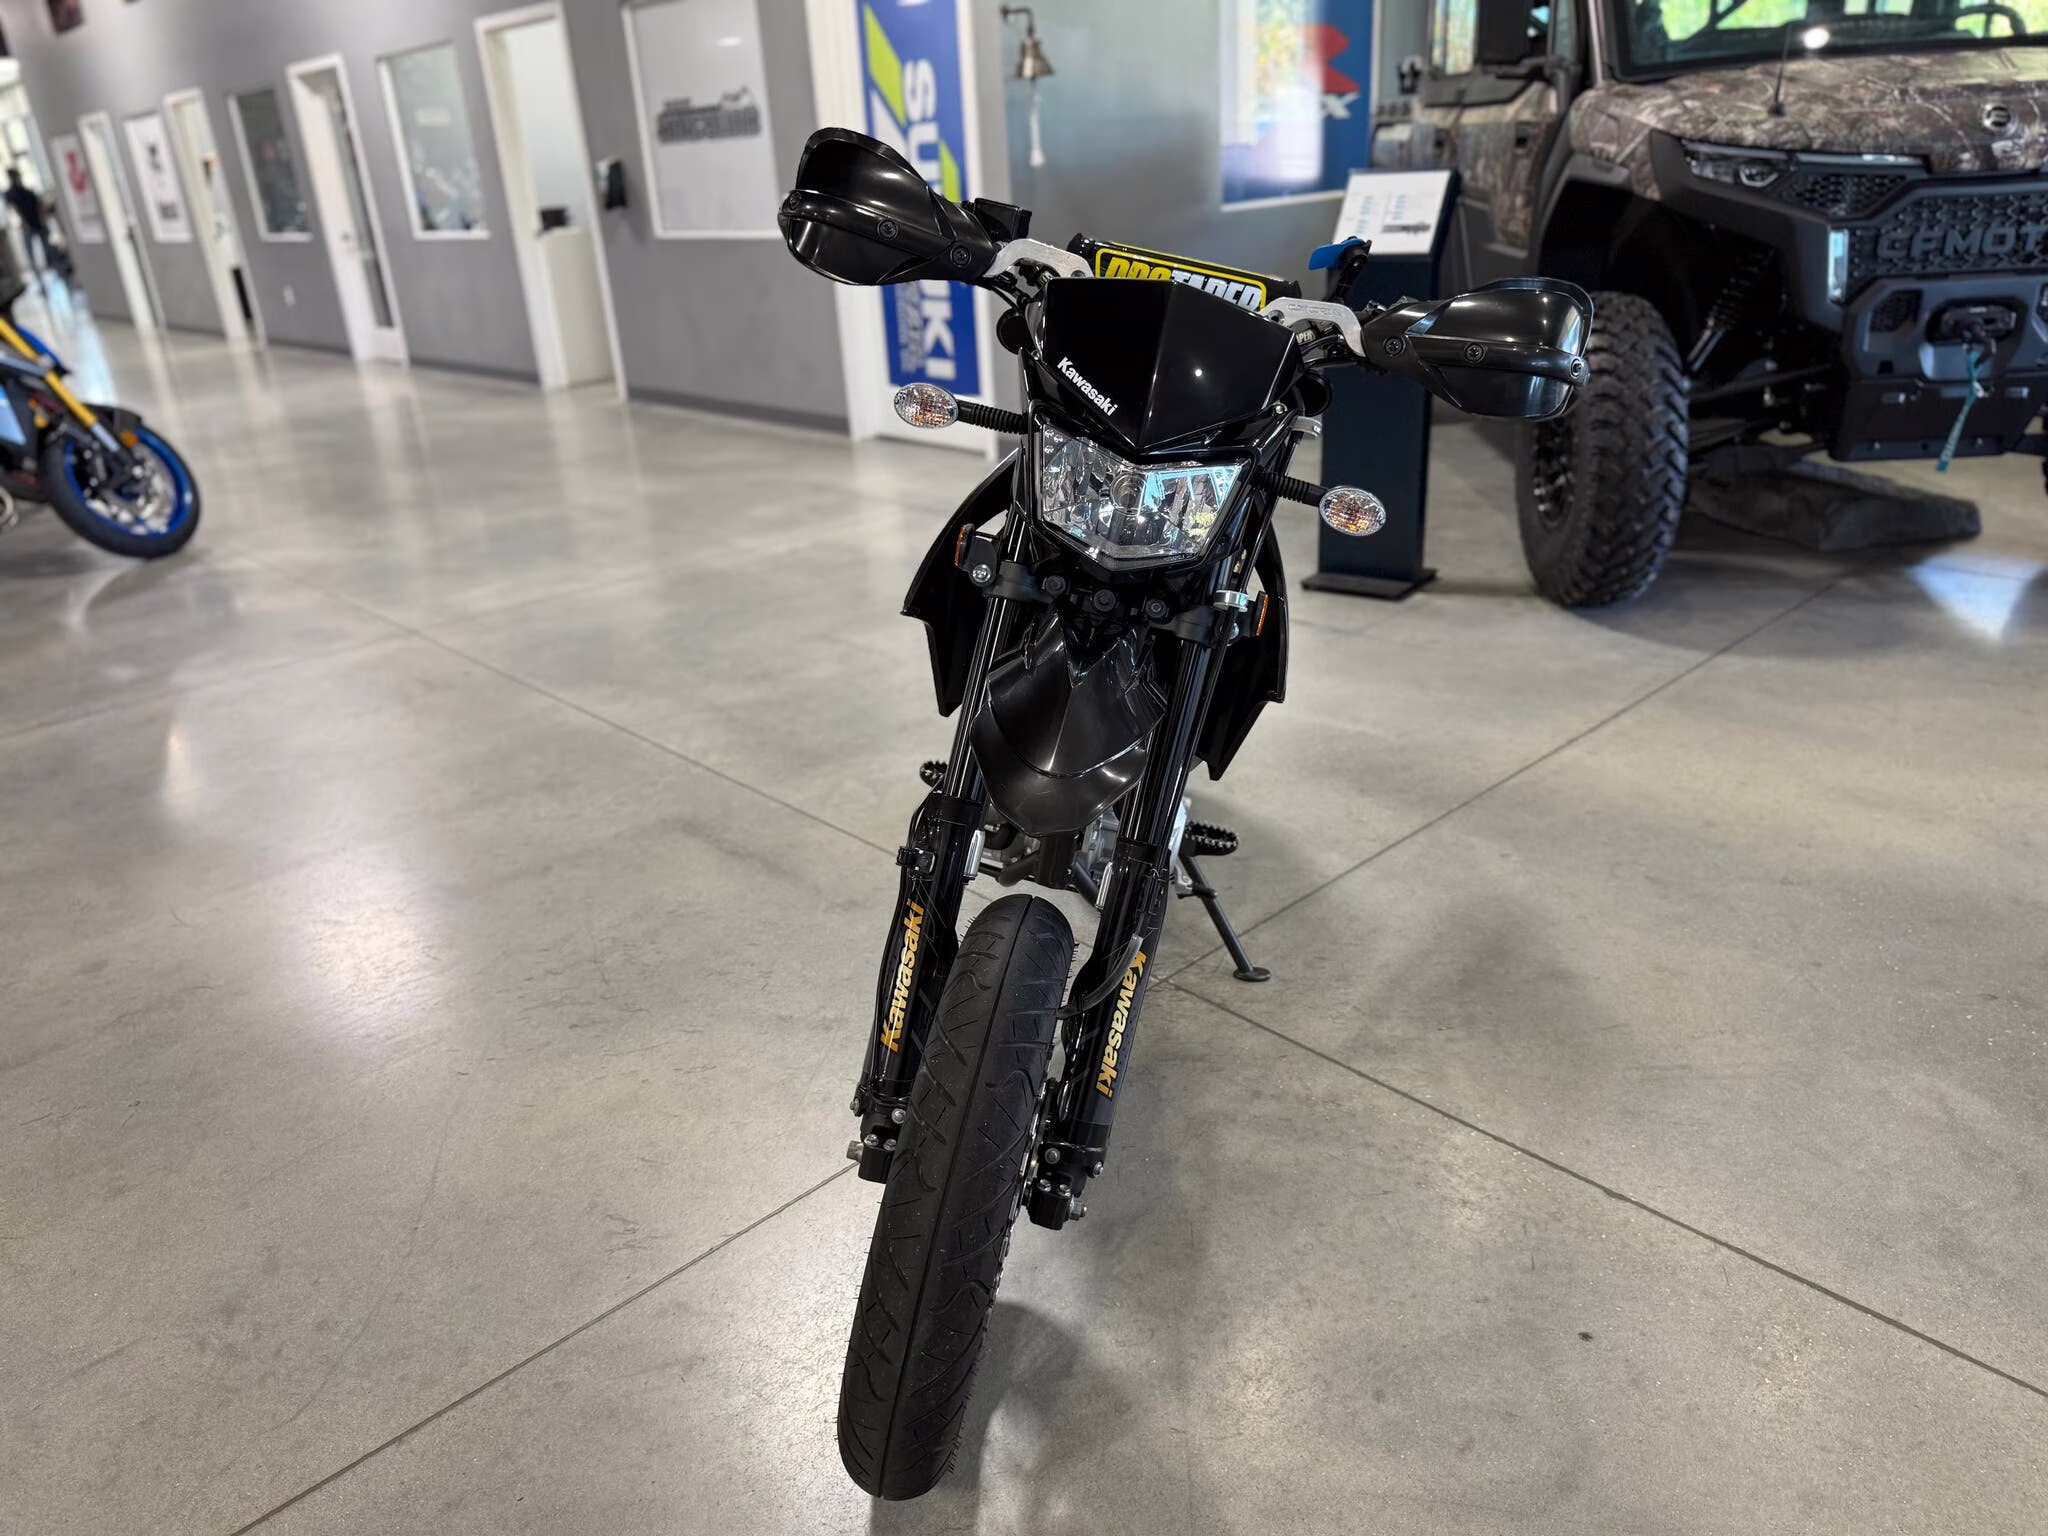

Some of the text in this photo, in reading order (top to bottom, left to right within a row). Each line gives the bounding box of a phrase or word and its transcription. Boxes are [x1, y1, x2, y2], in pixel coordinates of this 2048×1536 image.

[904, 58, 957, 379] SUKI
[1056, 356, 1119, 417] Kawasaki
[880, 900, 925, 1053] Kawasaki
[1096, 949, 1147, 1098] Kawasaki
